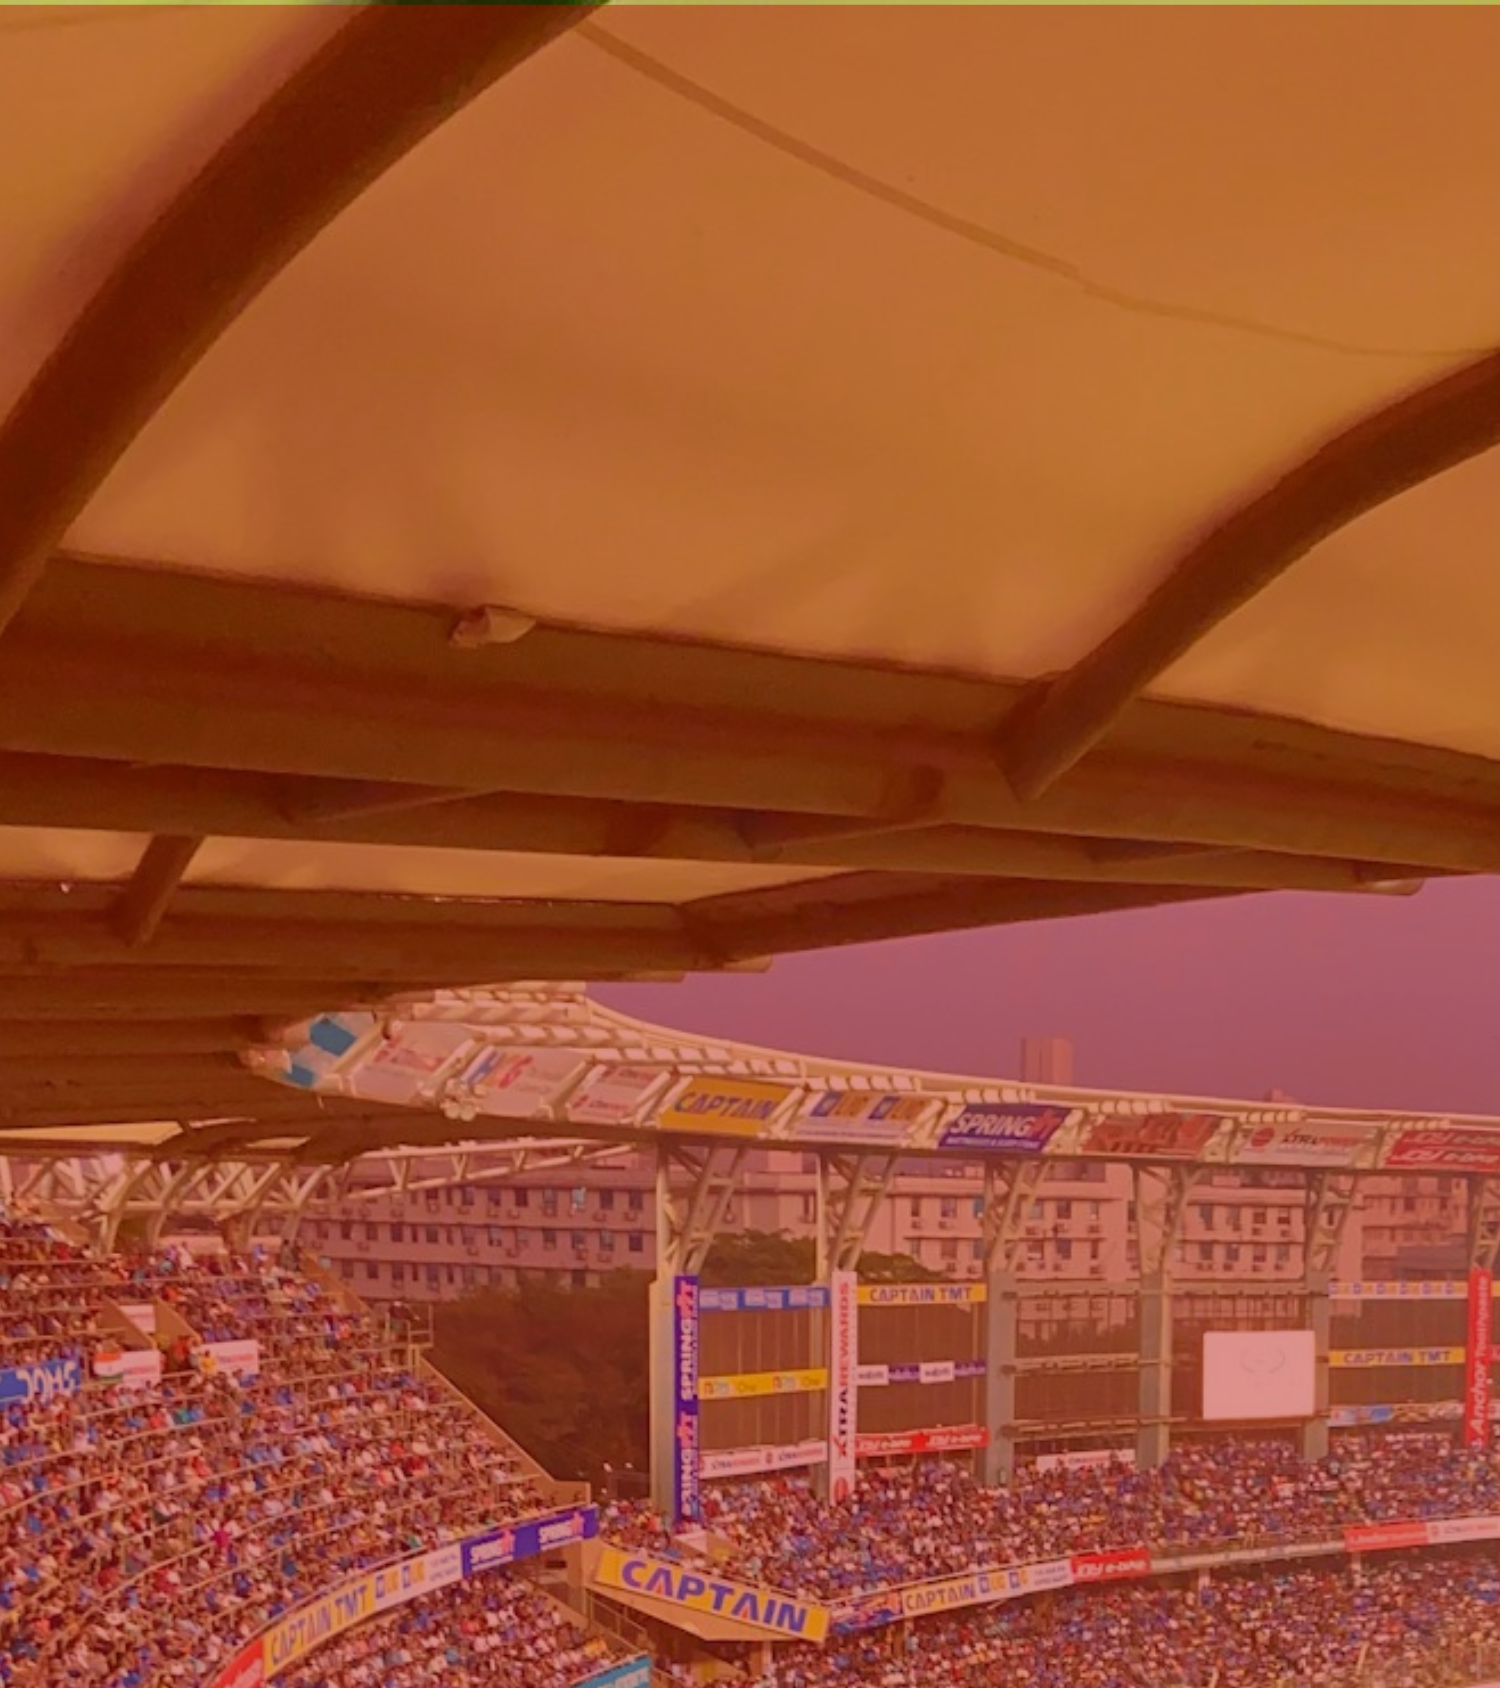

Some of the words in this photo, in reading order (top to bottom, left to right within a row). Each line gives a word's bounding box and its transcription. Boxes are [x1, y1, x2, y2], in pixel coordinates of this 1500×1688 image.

[674, 1089, 780, 1122] CAPTAIN
[870, 1288, 936, 1302] CAPTAIN
[940, 1287, 972, 1299] TMT
[1344, 1351, 1413, 1364] CAPTAIN
[1418, 1350, 1452, 1361] TMT
[1468, 1364, 1487, 1429] Anchor
[622, 1560, 807, 1632] CAPTAIN
[906, 1585, 976, 1611] CAPTAIN
[270, 1585, 331, 1664] CAPTAIN
[334, 1586, 368, 1625] TMT
